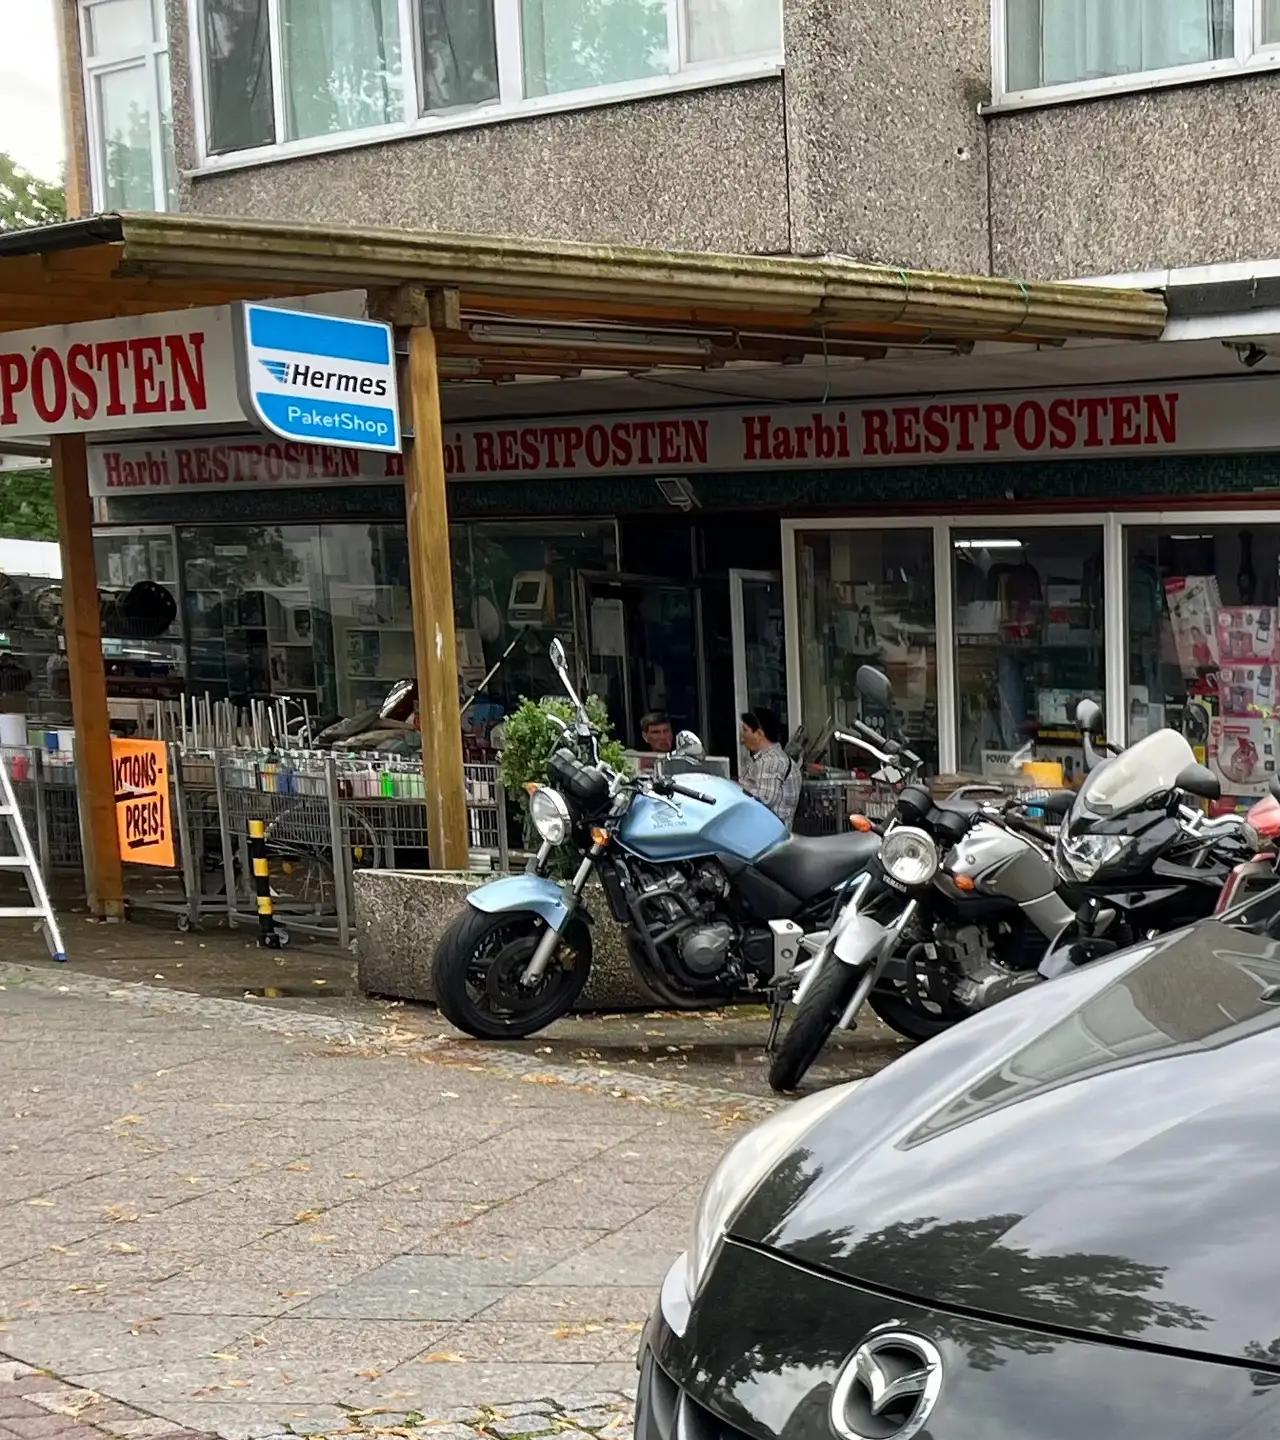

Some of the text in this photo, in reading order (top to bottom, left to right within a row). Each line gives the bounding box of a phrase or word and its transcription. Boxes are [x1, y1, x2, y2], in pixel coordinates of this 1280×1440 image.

[0, 332, 207, 426] POSTEN
[291, 364, 387, 396] Hermes
[287, 406, 389, 437] PaketShop
[742, 393, 1180, 460] Harbi RESTPOSTEN
[103, 442, 360, 487] Harbi RESTPOSTEN
[473, 420, 709, 472] RESTPOSTEN
[125, 794, 164, 841] PREIS!
